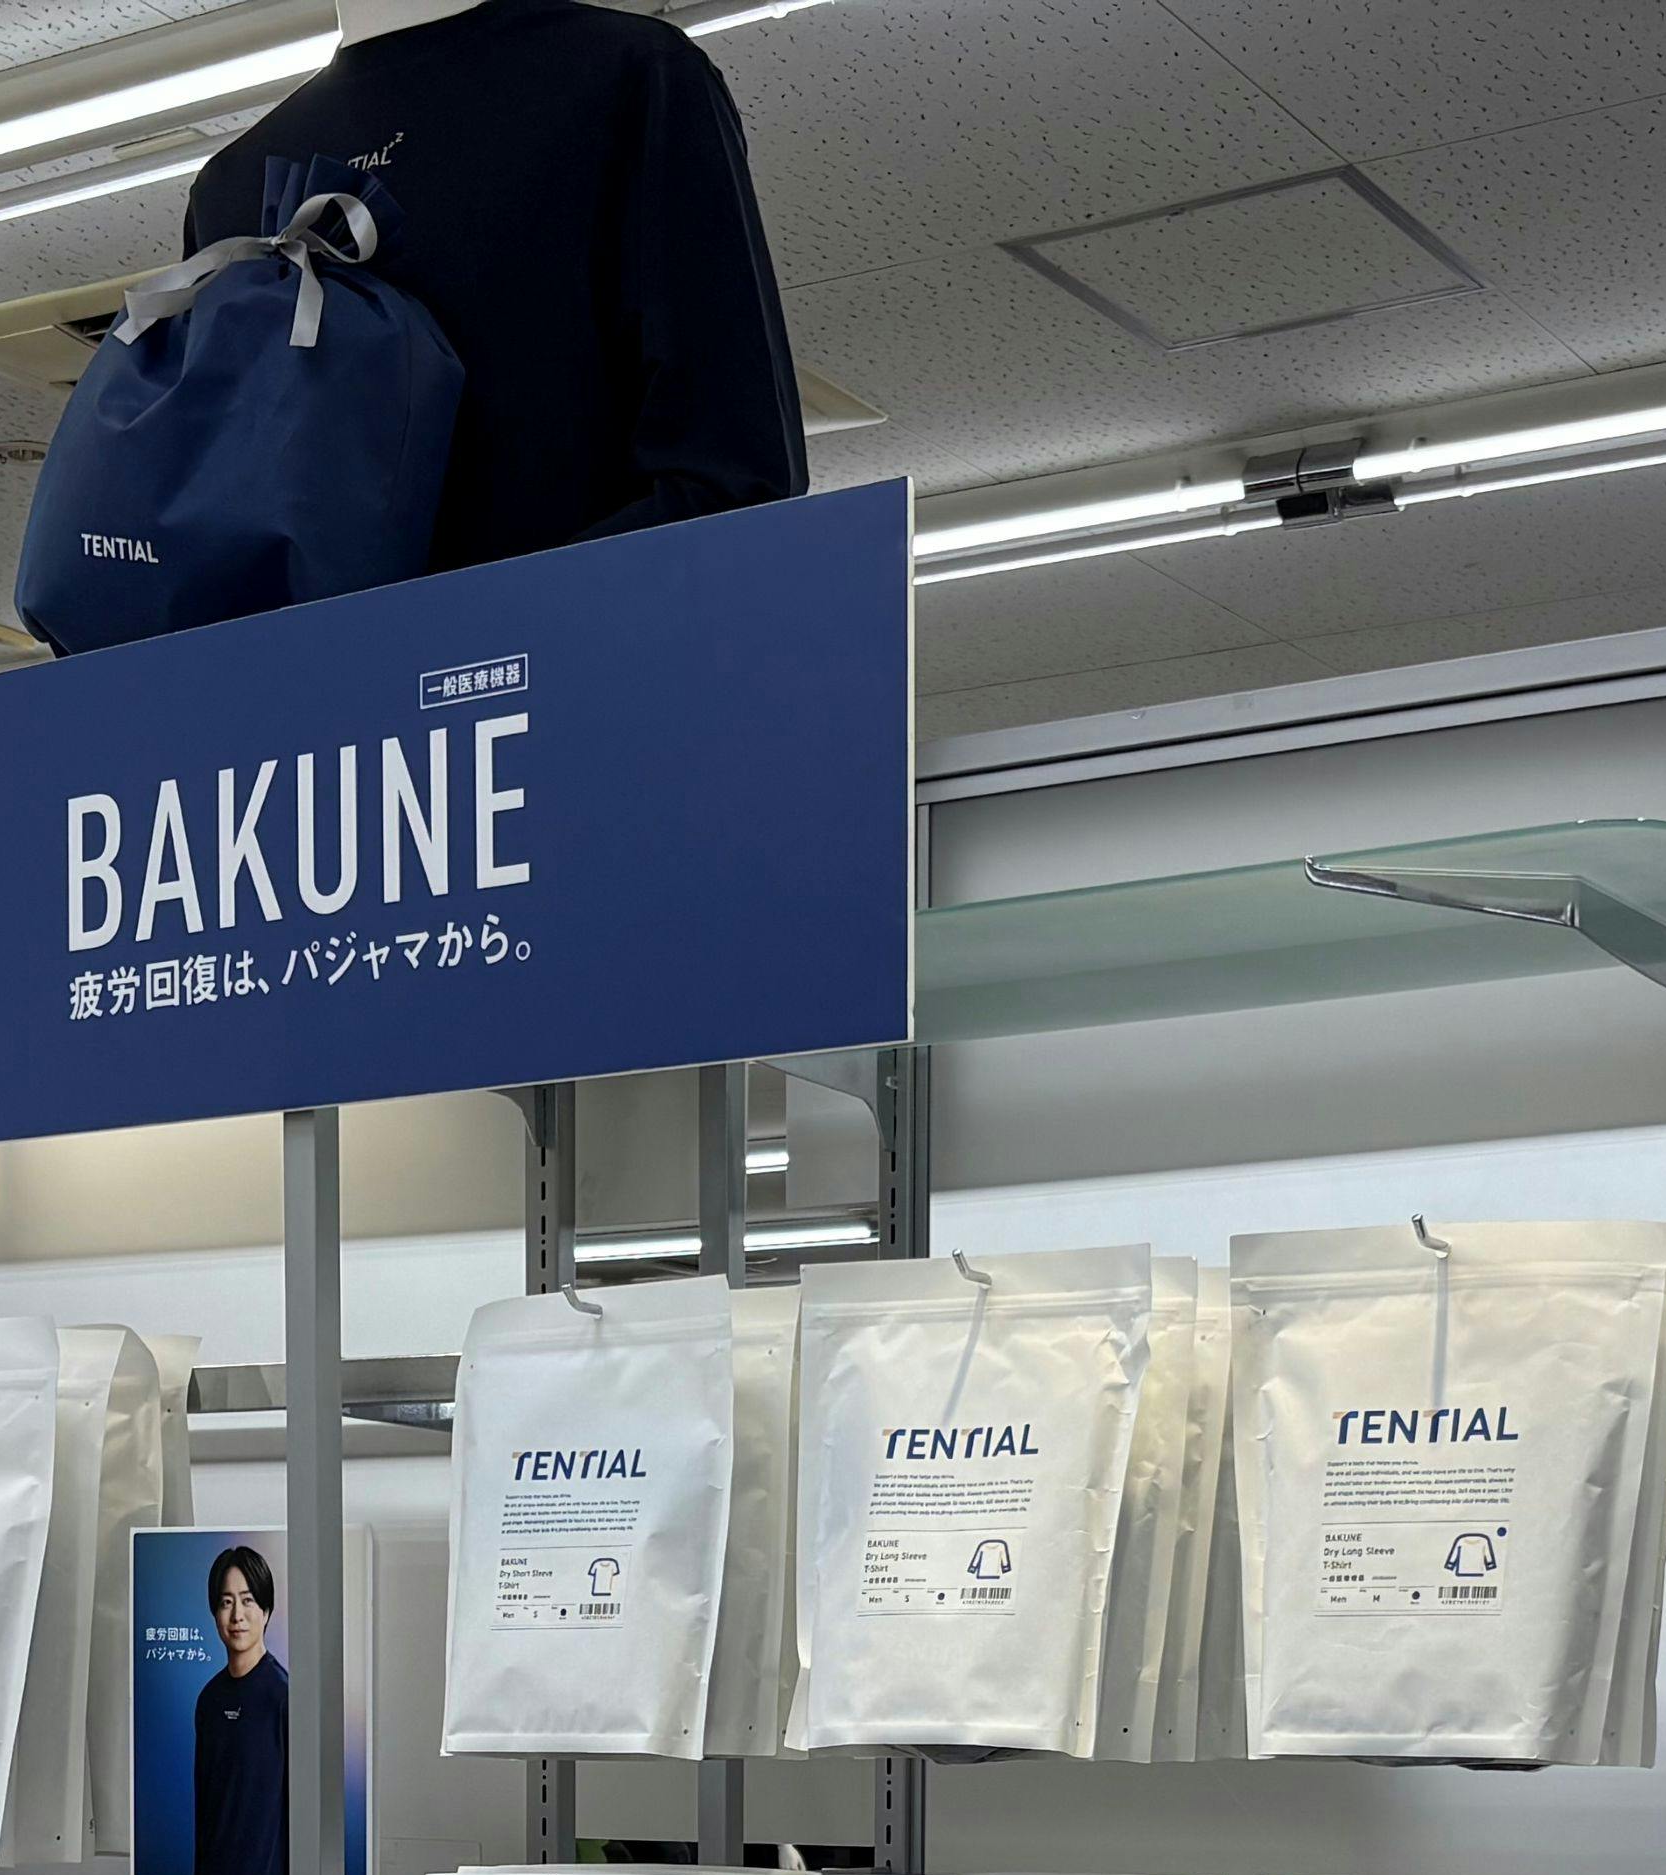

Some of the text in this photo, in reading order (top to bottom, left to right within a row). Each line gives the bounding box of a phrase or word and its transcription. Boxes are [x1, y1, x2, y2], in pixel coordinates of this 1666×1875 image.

[348, 146, 391, 170] TIAL
[81, 533, 159, 565] TENTIAL
[427, 663, 520, 697] 一般医療機器
[68, 712, 530, 952] BAKUNE
[69, 913, 531, 1021] 疲労回復は、パジャマから。
[1332, 1406, 1519, 1445] TENTIAL
[882, 1424, 1039, 1460] TENTIAL
[512, 1448, 647, 1481] TENTIAL
[867, 1539, 900, 1548] BAKUNE
[1324, 1546, 1395, 1558] Dry Long Sleeve
[1325, 1533, 1362, 1543] BAKUNE
[865, 1552, 879, 1562] Dry
[1323, 1560, 1352, 1570] T-Shirt
